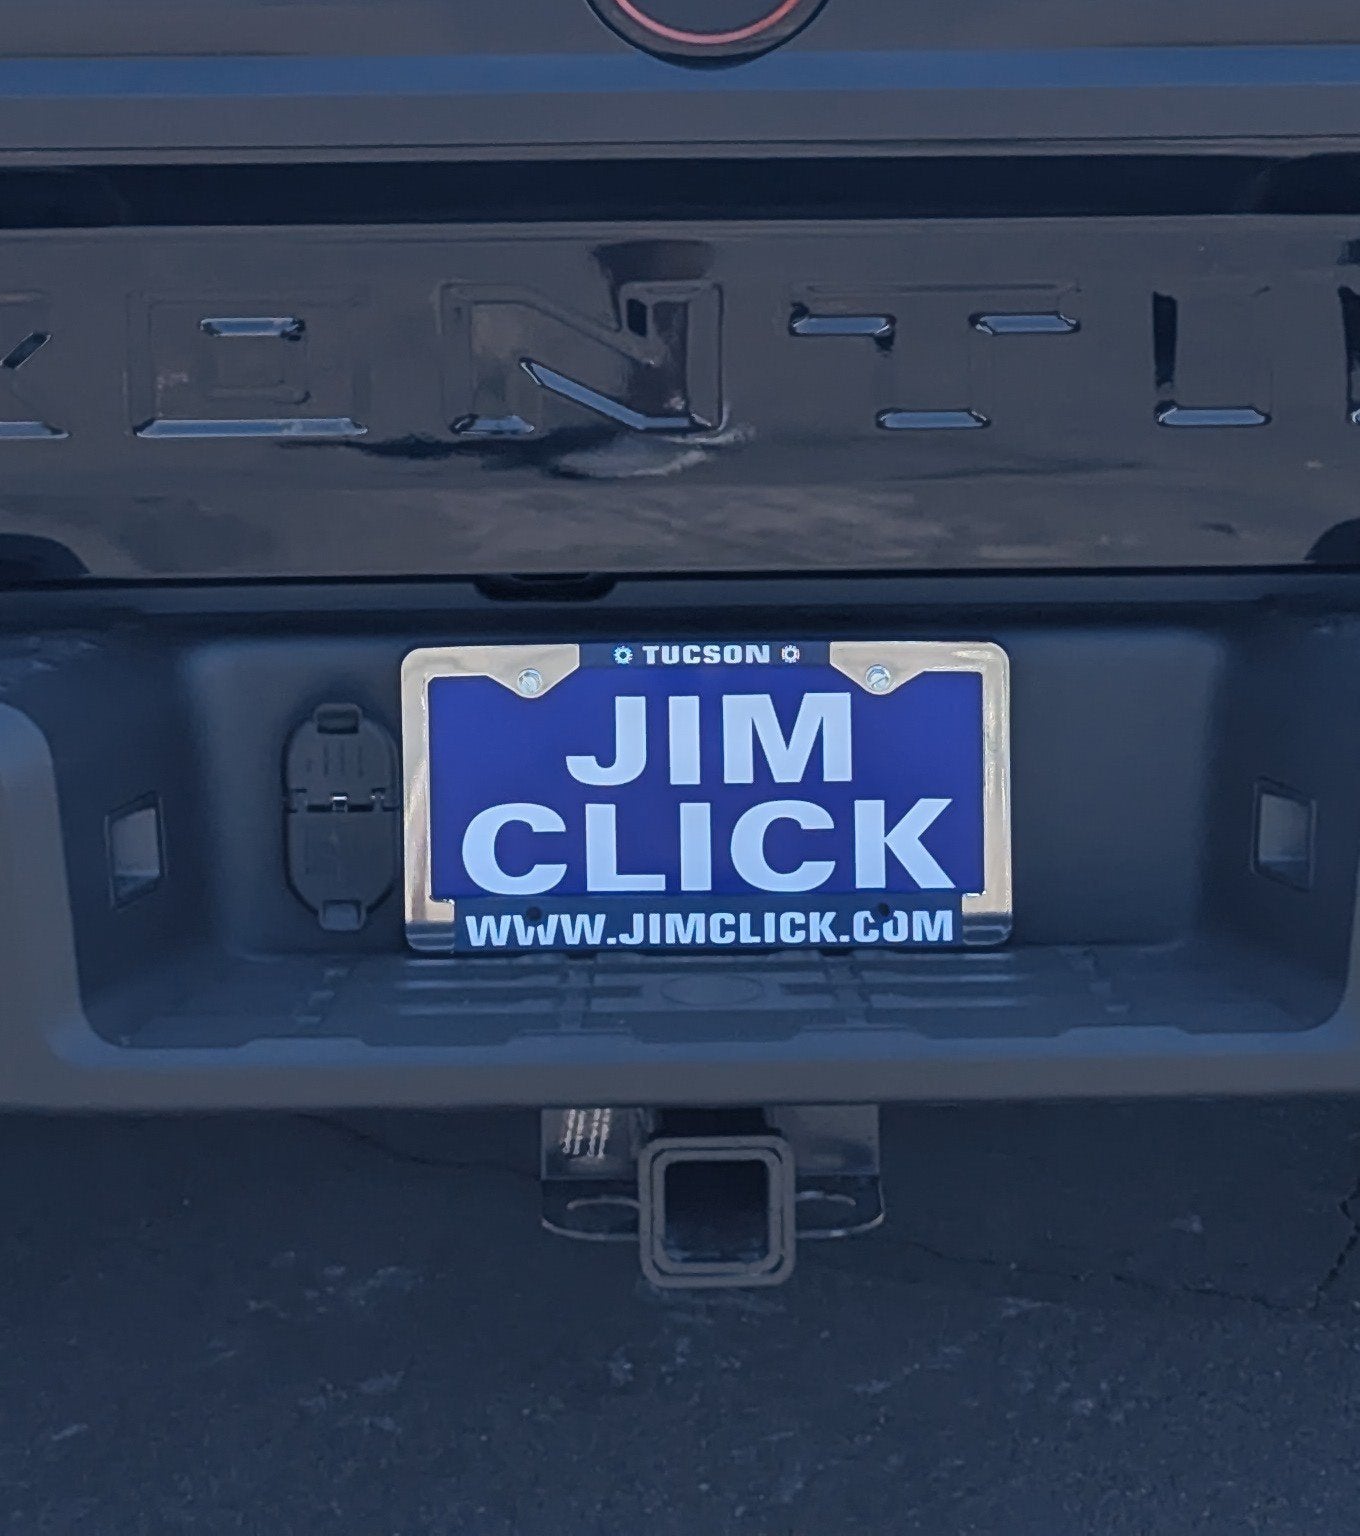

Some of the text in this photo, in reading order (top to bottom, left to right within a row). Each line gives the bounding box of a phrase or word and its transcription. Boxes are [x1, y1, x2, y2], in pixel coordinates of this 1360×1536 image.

[642, 644, 770, 664] TUCSON
[565, 692, 853, 787] JIM
[461, 797, 956, 895] CLICK
[465, 910, 954, 947] WWW.JIMCLICK.COM
